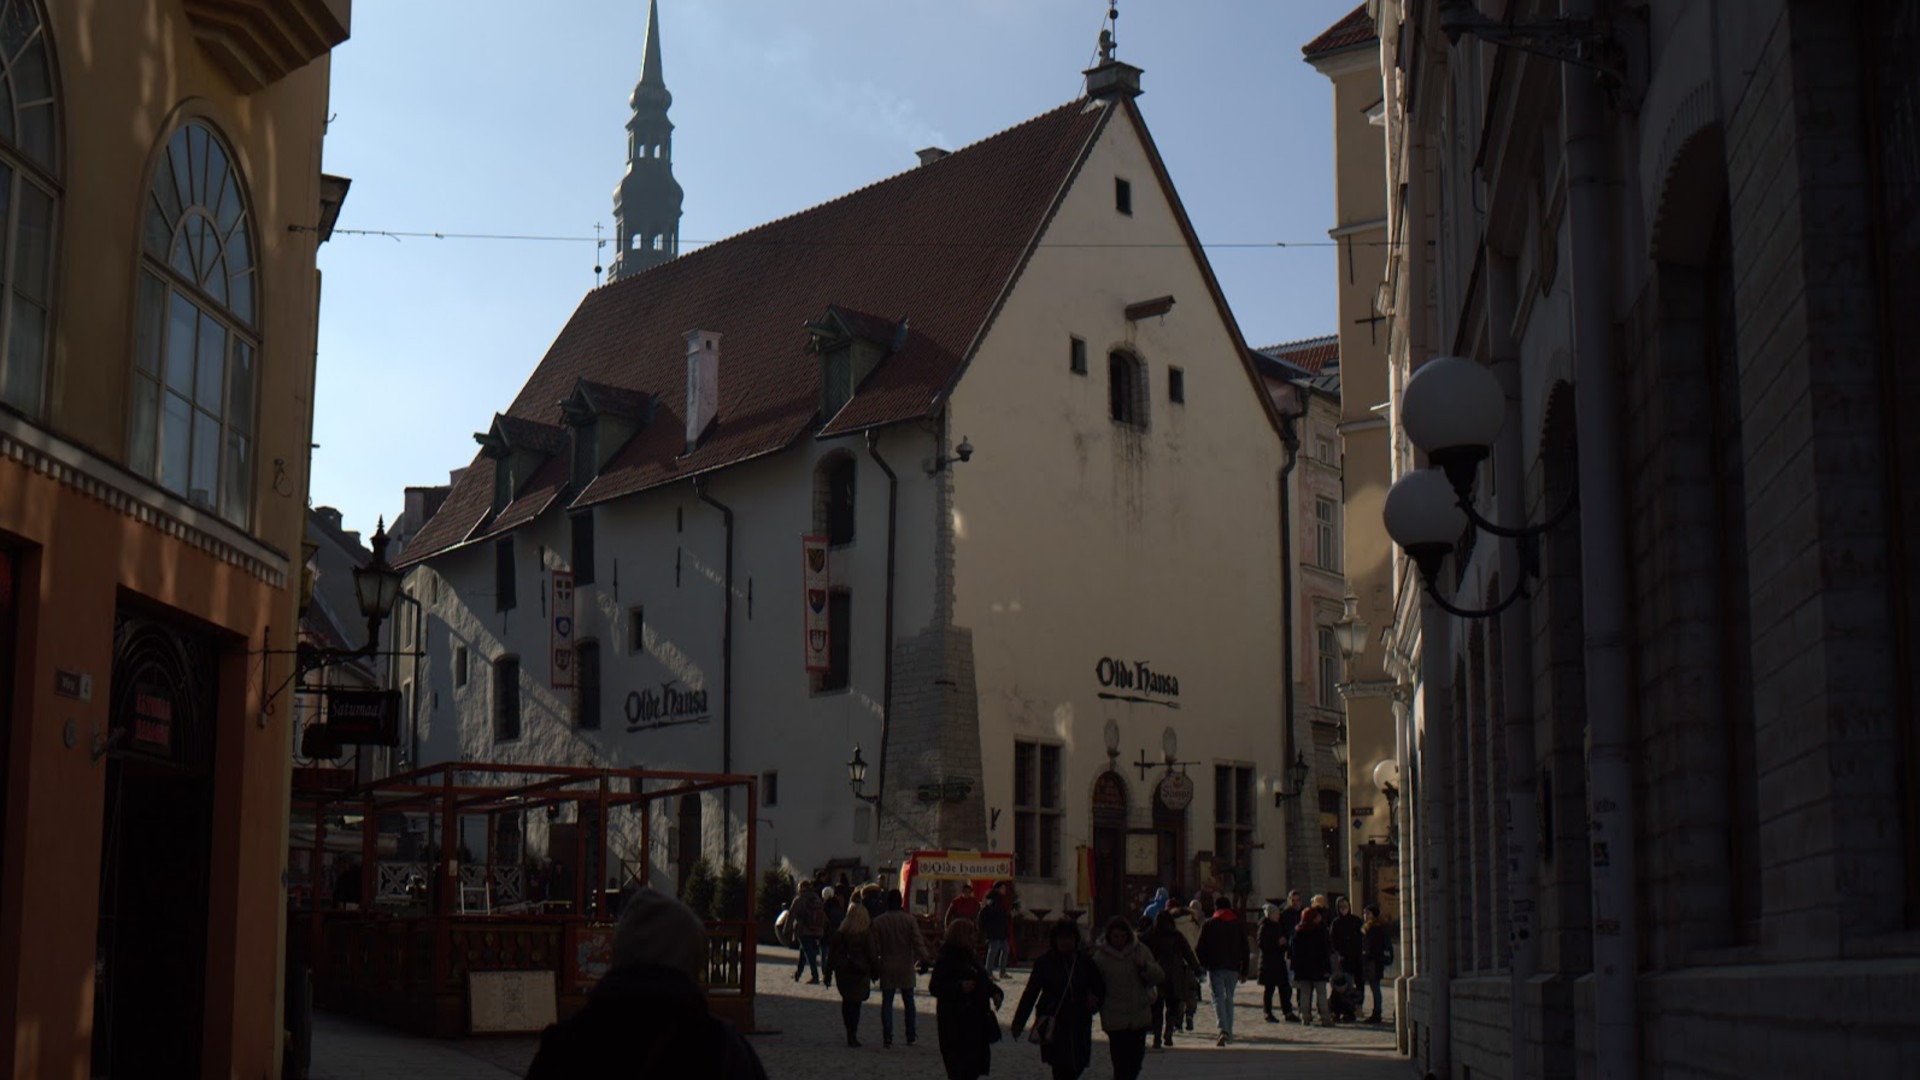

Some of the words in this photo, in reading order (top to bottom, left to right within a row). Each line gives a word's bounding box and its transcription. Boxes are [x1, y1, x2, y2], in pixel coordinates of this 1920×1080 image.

[1095, 656, 1134, 688] Olde
[332, 699, 379, 718] Satumaa
[624, 691, 660, 724] Olde
[931, 861, 957, 873] Olde
